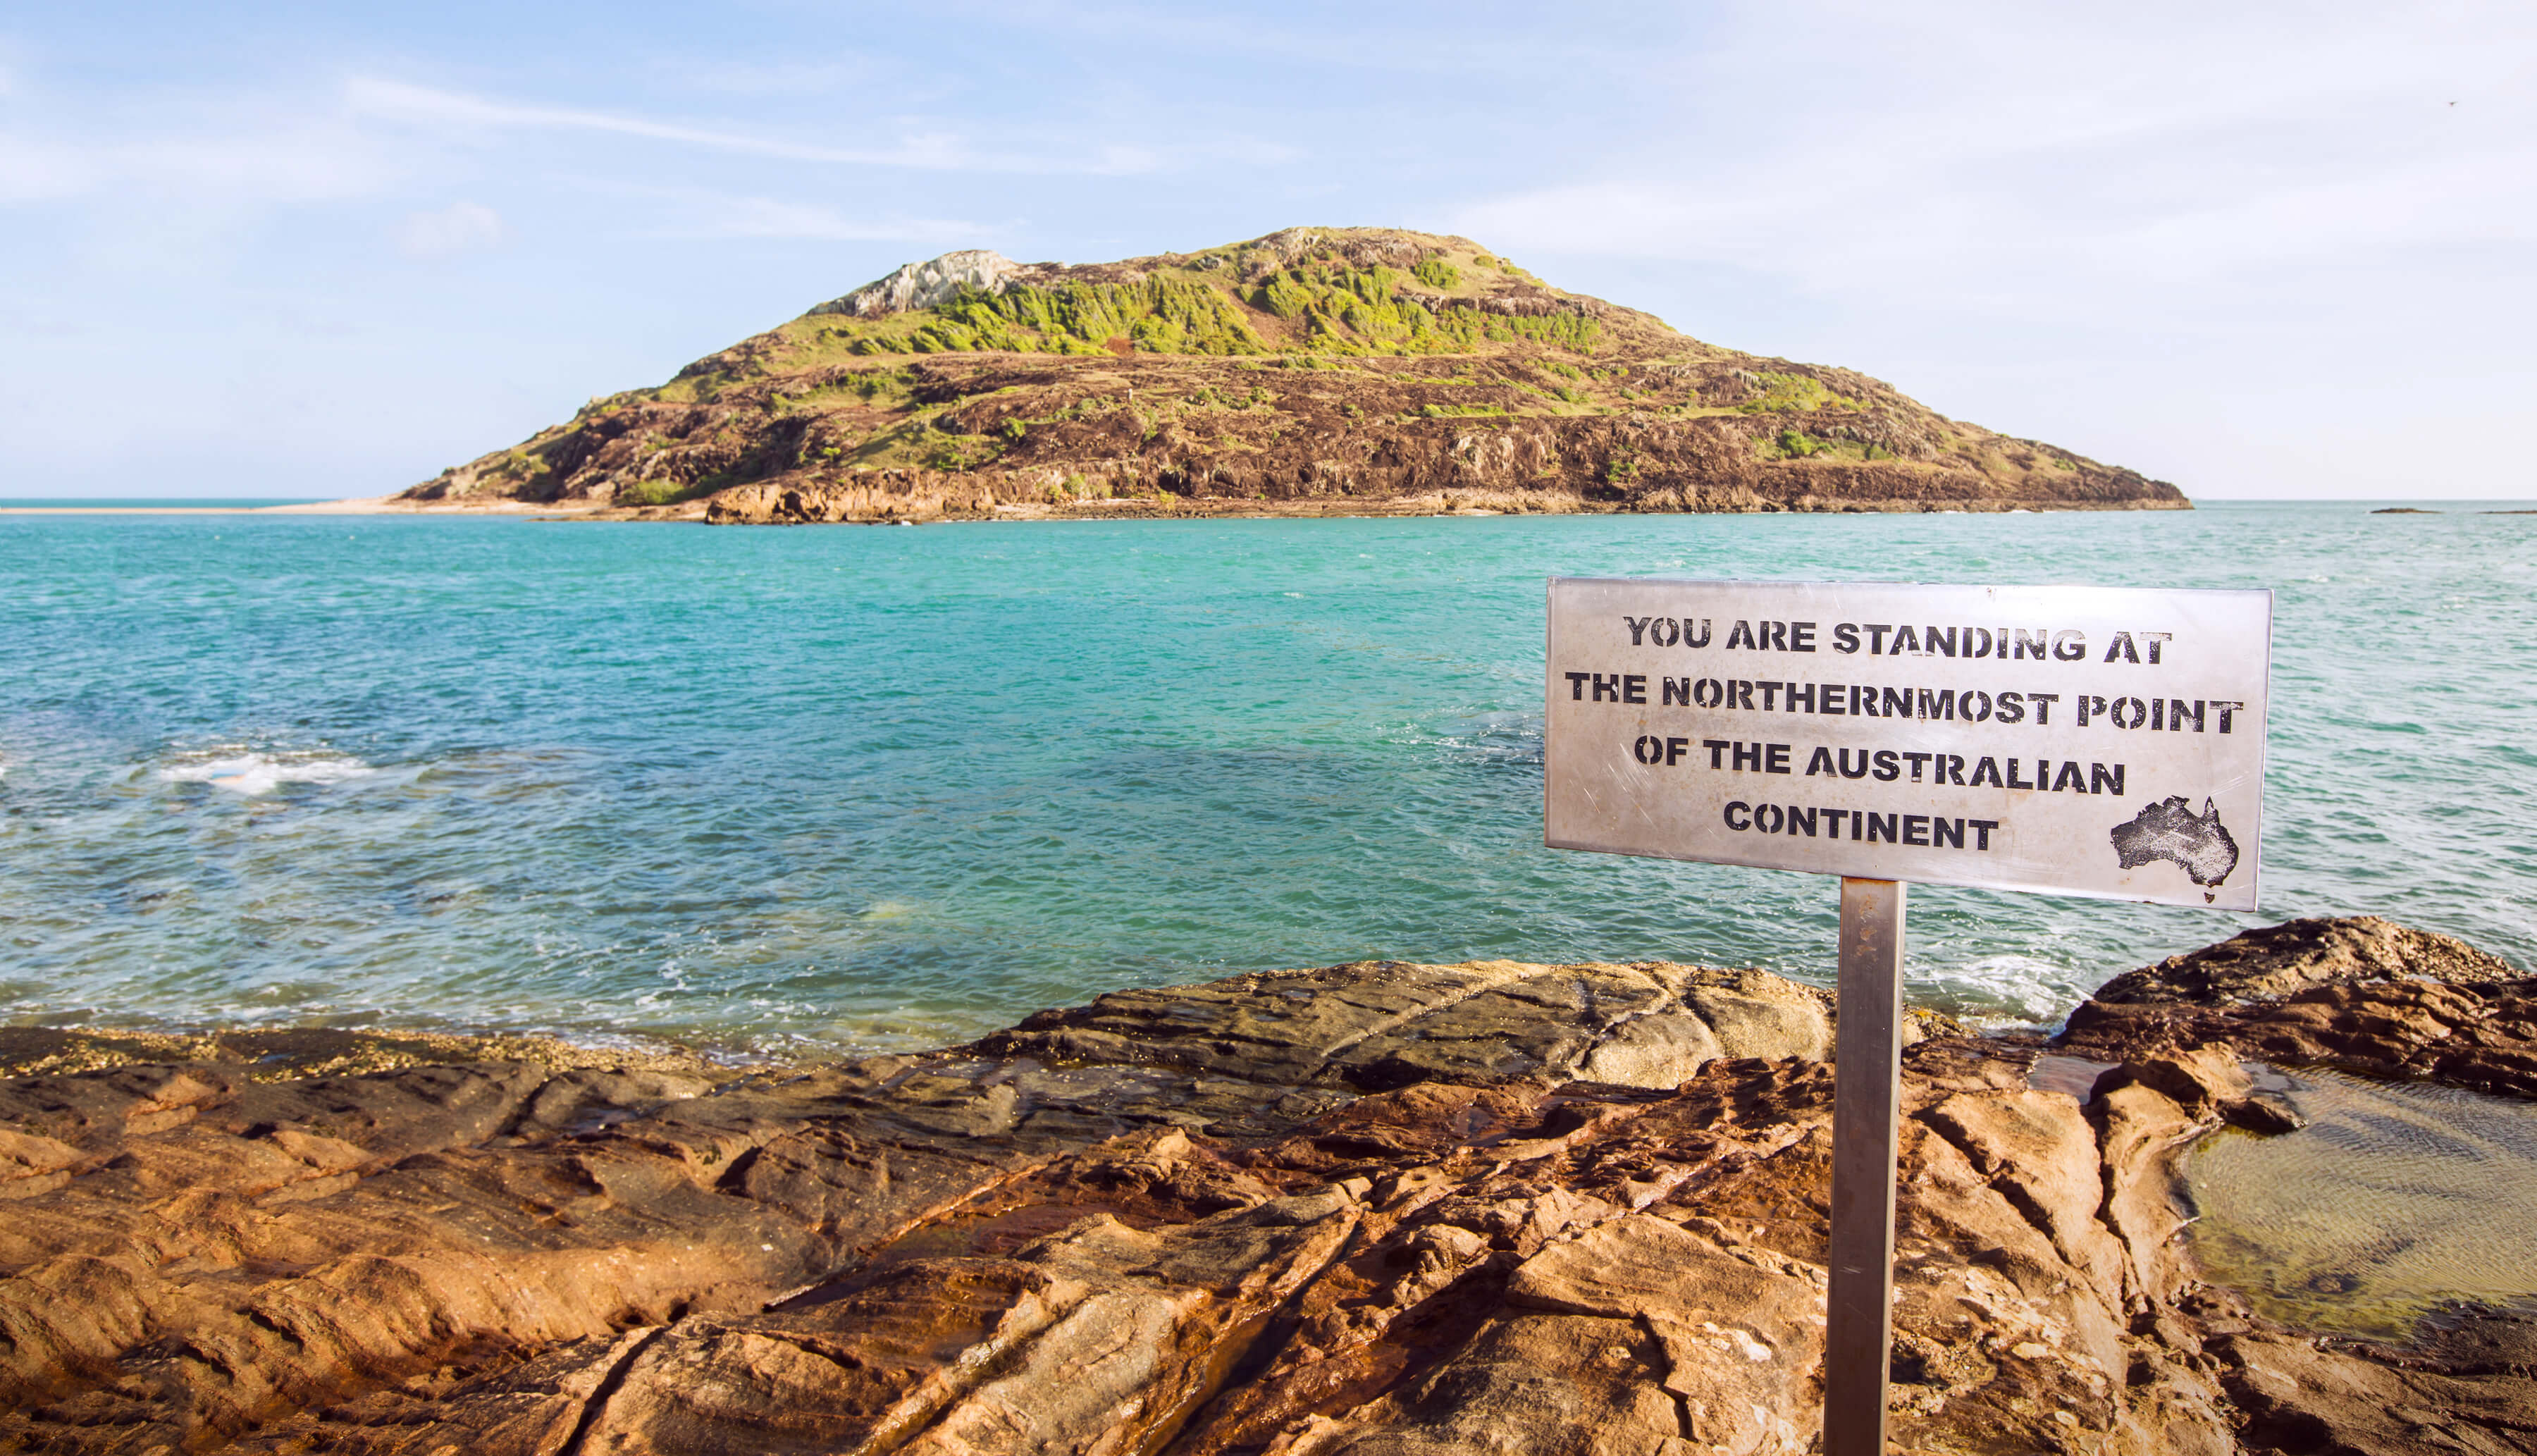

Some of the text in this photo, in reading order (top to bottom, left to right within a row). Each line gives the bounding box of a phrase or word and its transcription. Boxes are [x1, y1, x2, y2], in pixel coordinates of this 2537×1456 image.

[1624, 617, 2173, 664] YOU ARE STANDING AT
[1565, 672, 2243, 734] THE NORTHERNMOST POINT
[1634, 736, 2124, 796] OF THE AUSTRALIAN
[1724, 801, 1999, 851] CONTINENT
